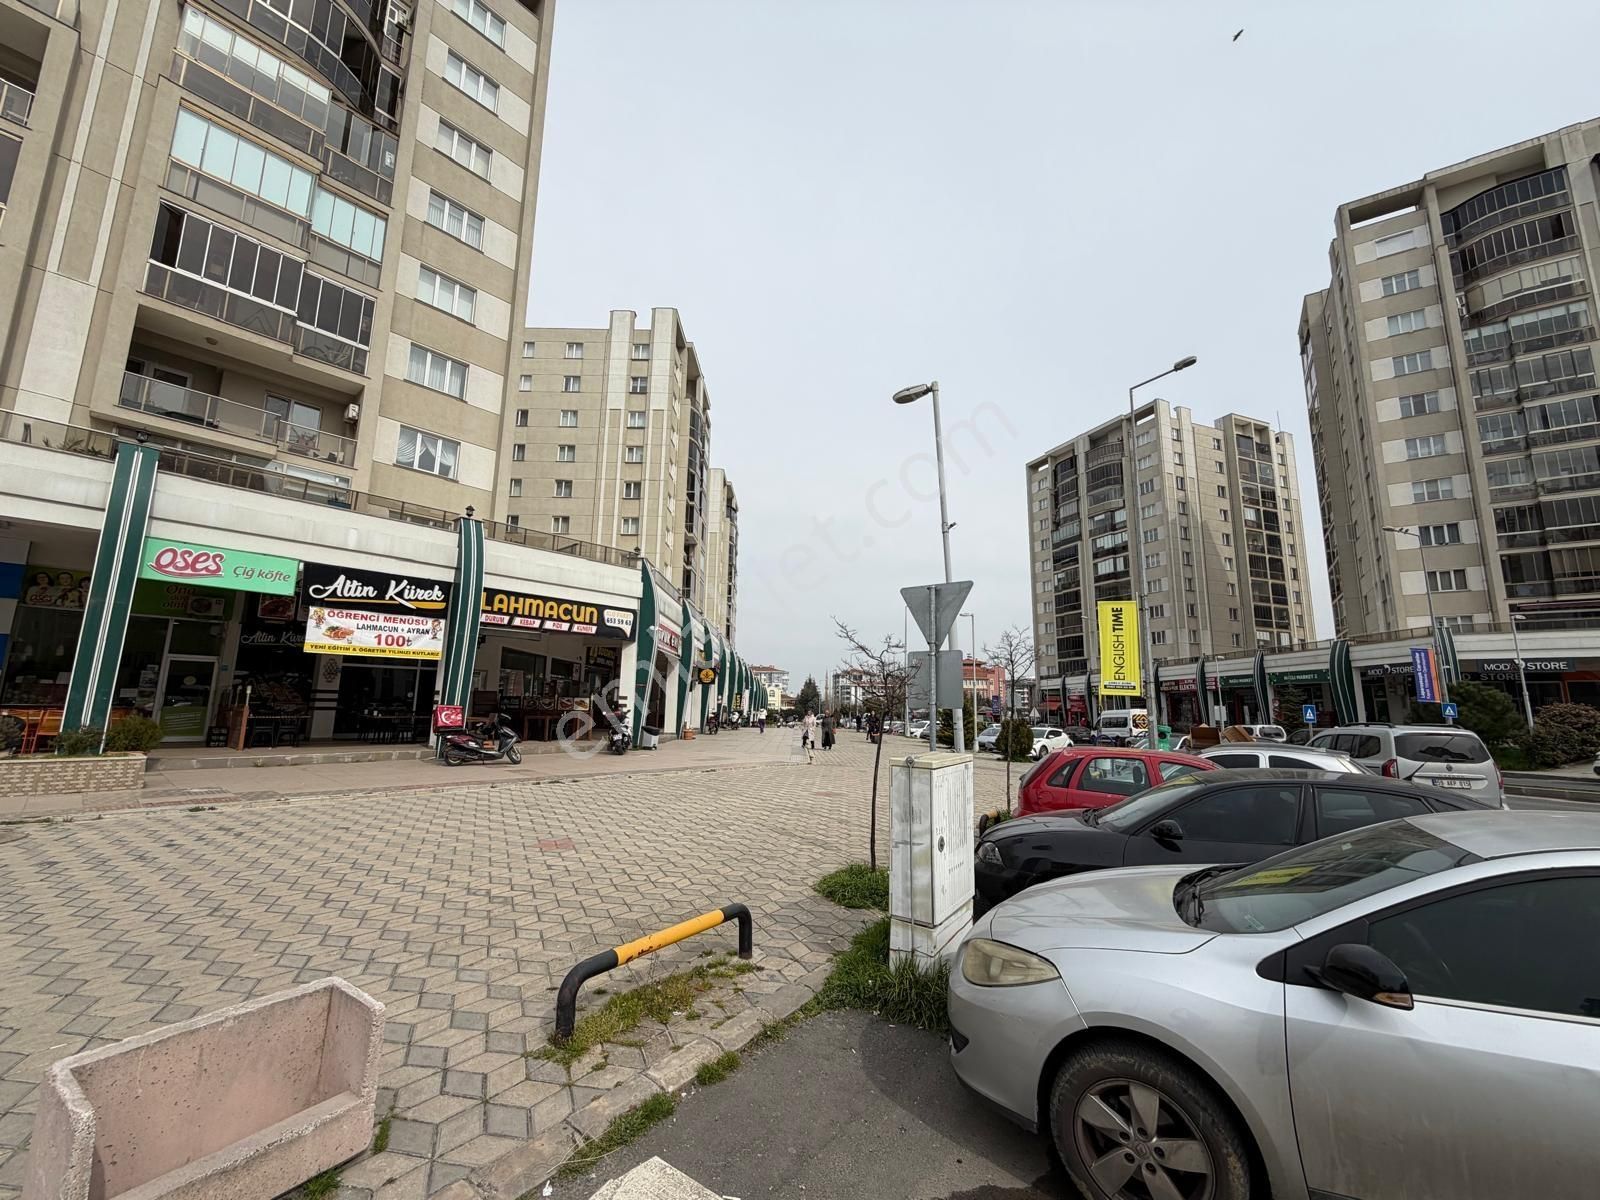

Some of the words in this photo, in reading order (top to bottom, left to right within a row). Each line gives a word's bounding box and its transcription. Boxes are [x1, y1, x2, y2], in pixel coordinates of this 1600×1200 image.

[233, 565, 255, 580] Çiğ
[258, 568, 291, 582] köfte
[385, 579, 445, 609] Kürek
[327, 610, 380, 623] ÖĞRENCİ
[383, 616, 428, 626] MENÜSÜ
[1111, 607, 1124, 632] TIME
[356, 623, 399, 633] LAHMACUN
[1112, 634, 1126, 681] ENGLISH
[1527, 661, 1569, 670] STORE
[1391, 666, 1415, 674] STORE
